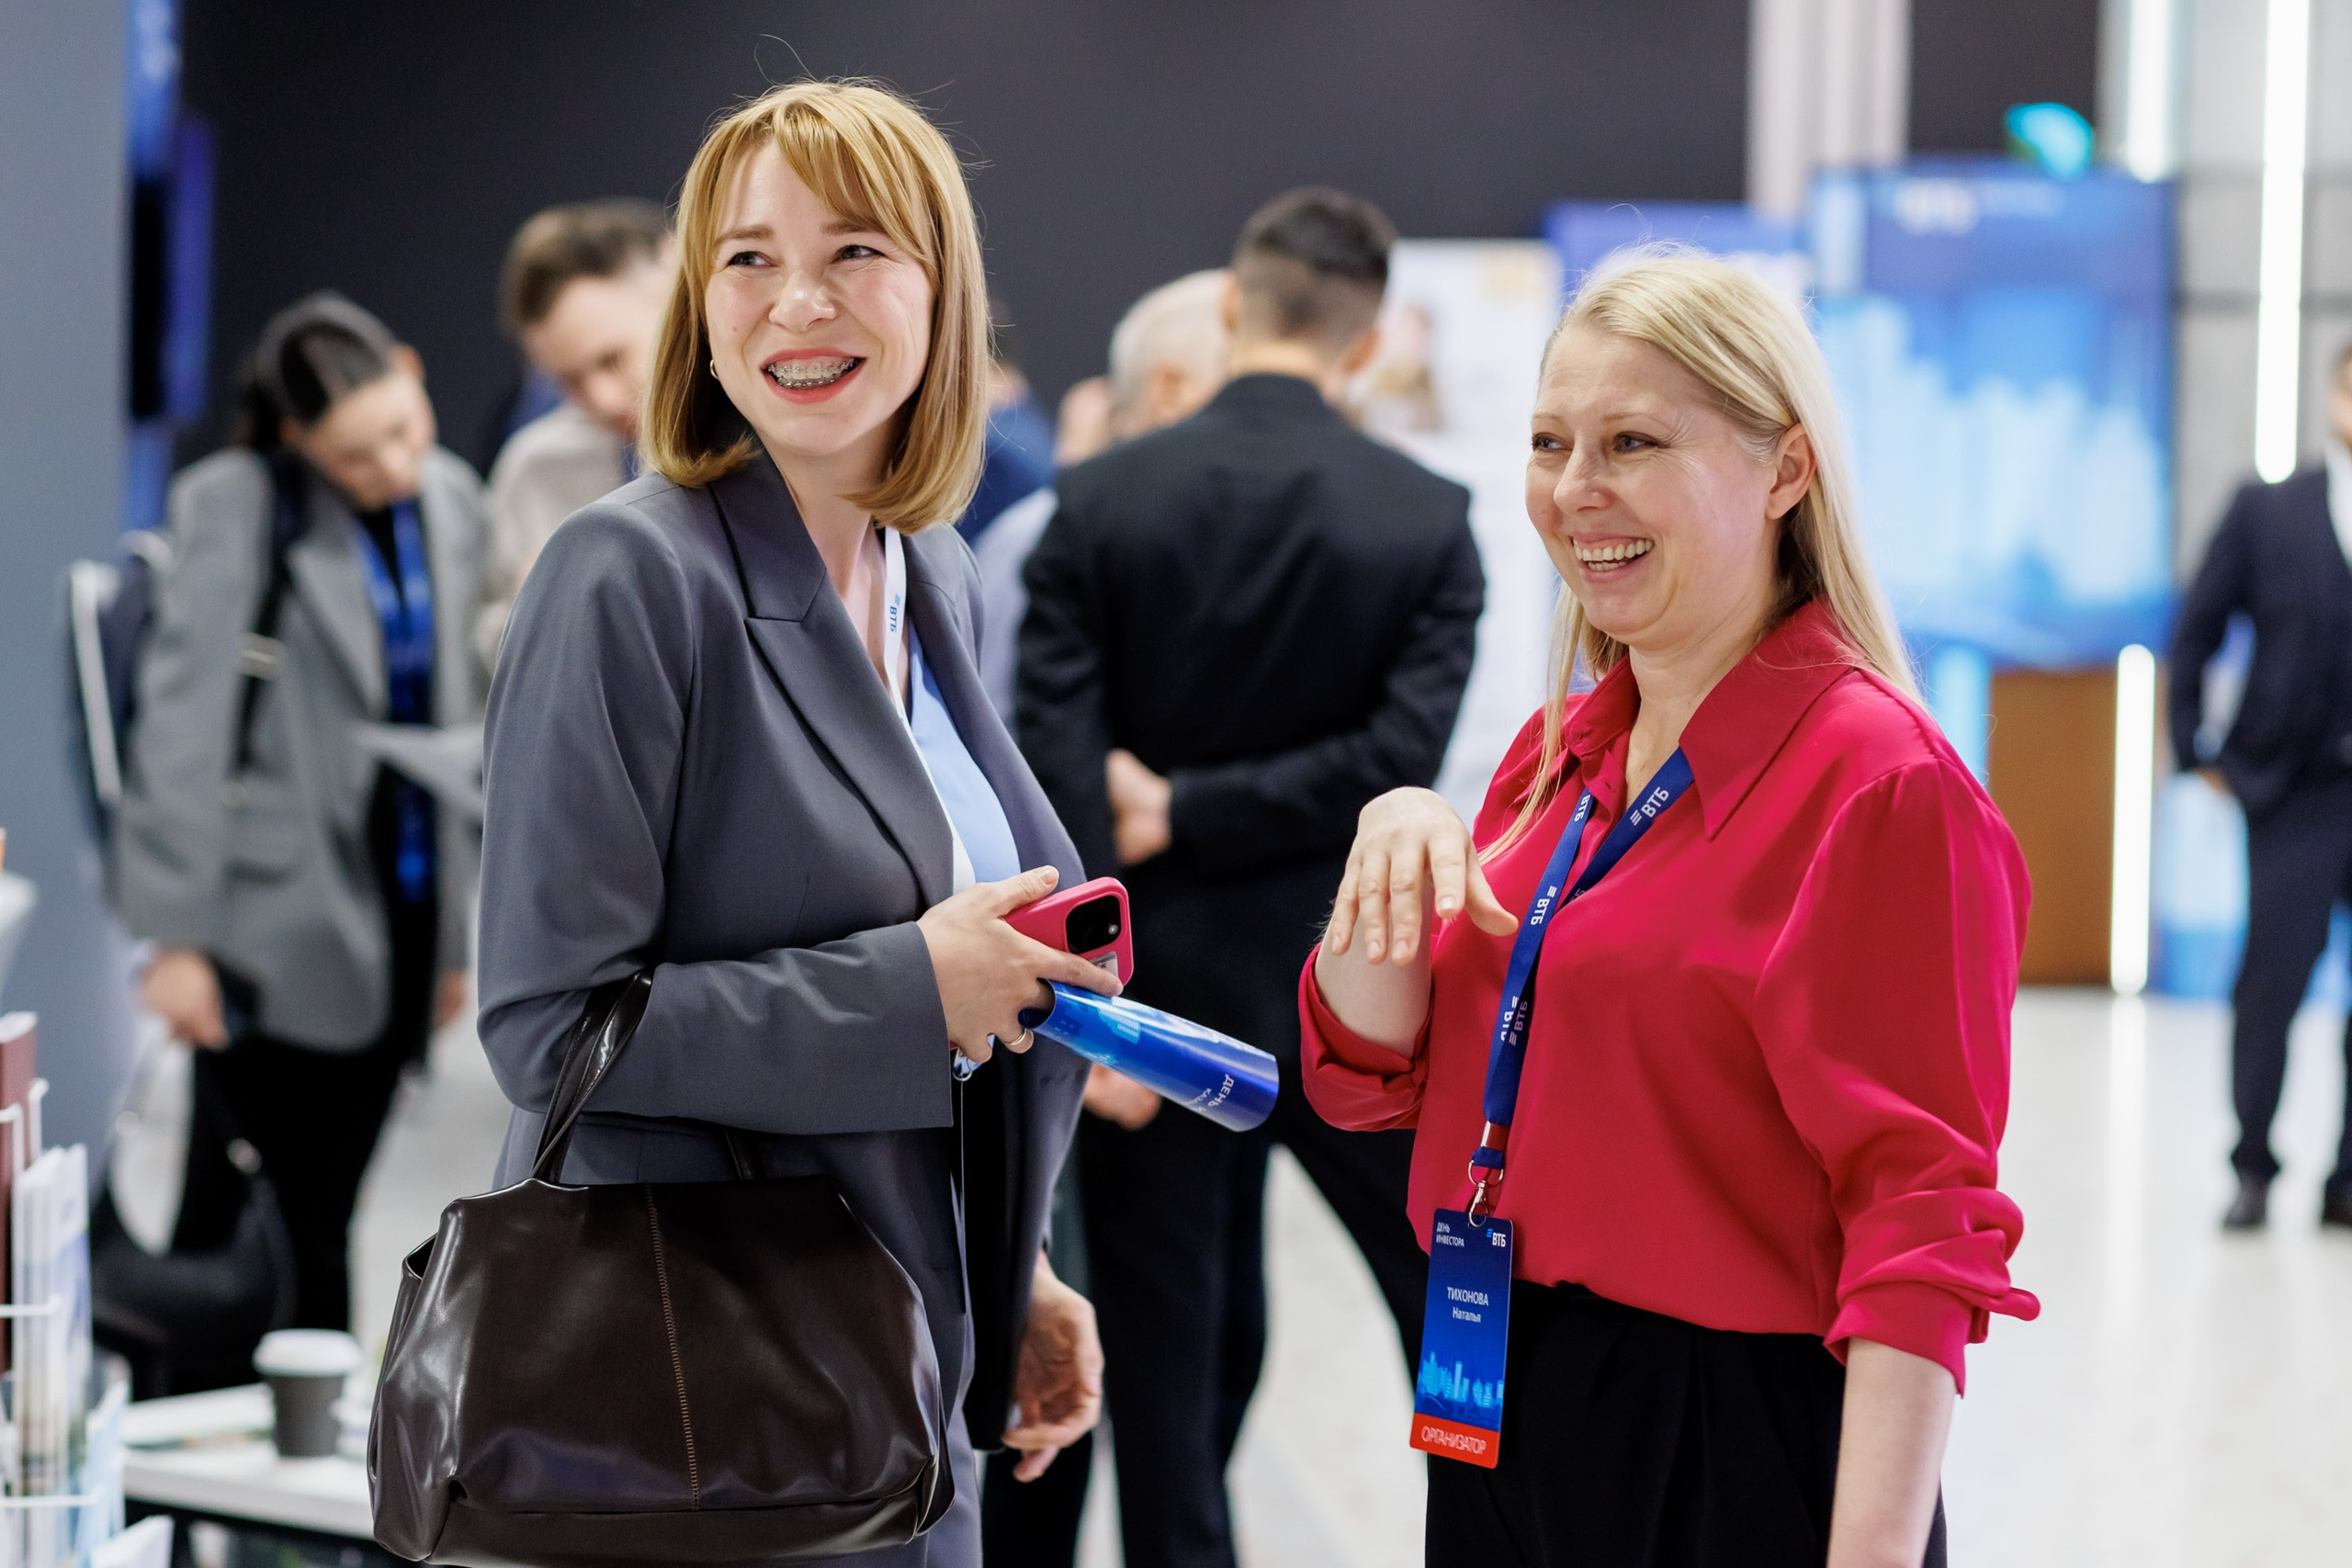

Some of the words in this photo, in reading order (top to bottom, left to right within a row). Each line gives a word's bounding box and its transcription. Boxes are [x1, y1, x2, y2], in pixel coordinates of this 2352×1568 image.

[889, 605, 898, 633] ВТБ
[1574, 794, 1591, 822] ВТБ
[1640, 786, 1669, 818] ВТБ
[1531, 898, 1550, 925] ВТБ
[1514, 1000, 1528, 1031] ВТБ
[1208, 1074, 1235, 1107] ДЕНЬ
[1436, 1222, 1451, 1234] ДЕНЬ
[1436, 1234, 1464, 1247] ИНВЕСТОРА
[1491, 1232, 1507, 1247] ВТБ
[1447, 1286, 1489, 1306] ТИХОНОВА
[1453, 1306, 1482, 1323] Наталья
[1420, 1425, 1487, 1455] ОРГАНИЗАТОР
